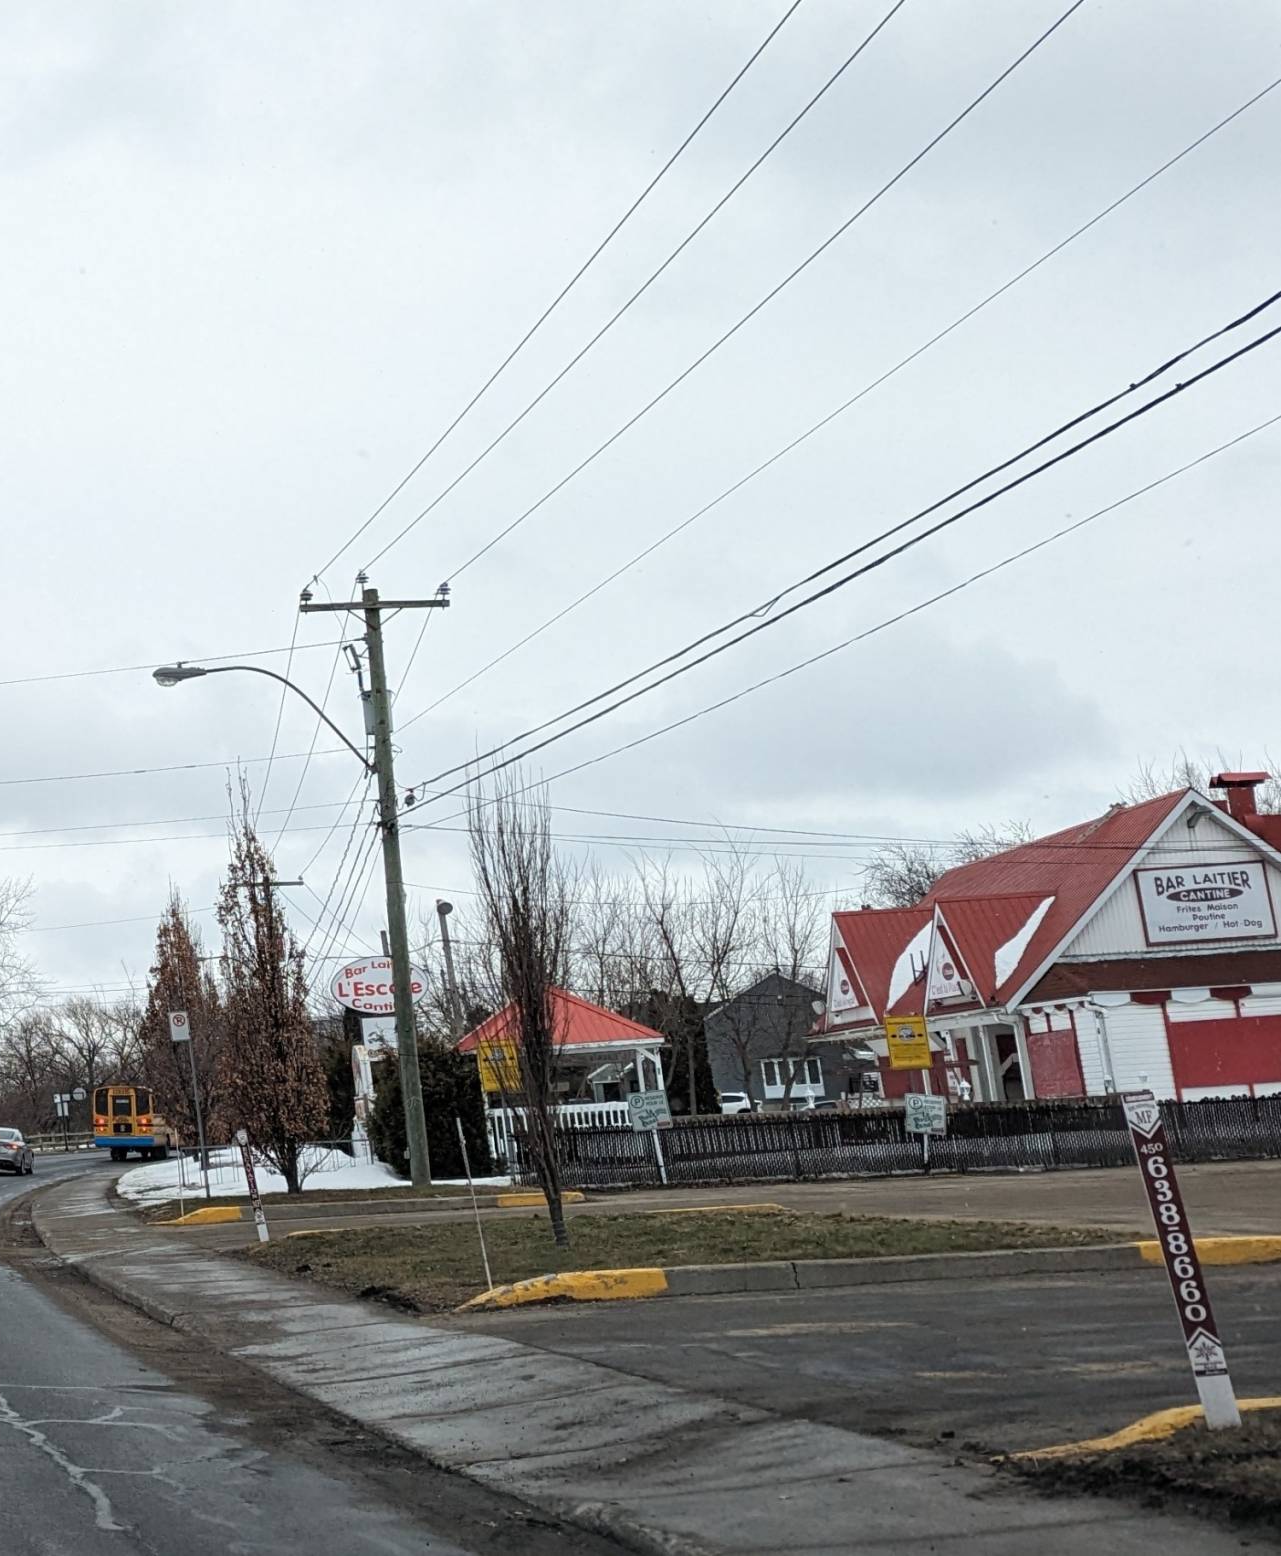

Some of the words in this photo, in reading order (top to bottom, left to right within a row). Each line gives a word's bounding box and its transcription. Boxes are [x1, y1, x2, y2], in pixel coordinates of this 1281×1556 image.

[1154, 875, 1186, 896] BAR
[1193, 870, 1252, 889] LAITIER
[1179, 888, 1231, 900] CANTINE
[1177, 904, 1202, 913] Frites
[1207, 903, 1239, 911] Maison
[1192, 913, 1226, 921] Poutine
[1158, 923, 1209, 932] Hamburger
[345, 966, 367, 979] Bar
[352, 998, 394, 1011] Canti
[1134, 1110, 1153, 1125] MF
[1140, 1143, 1163, 1155] 450
[1147, 1156, 1207, 1322] 638-8660
